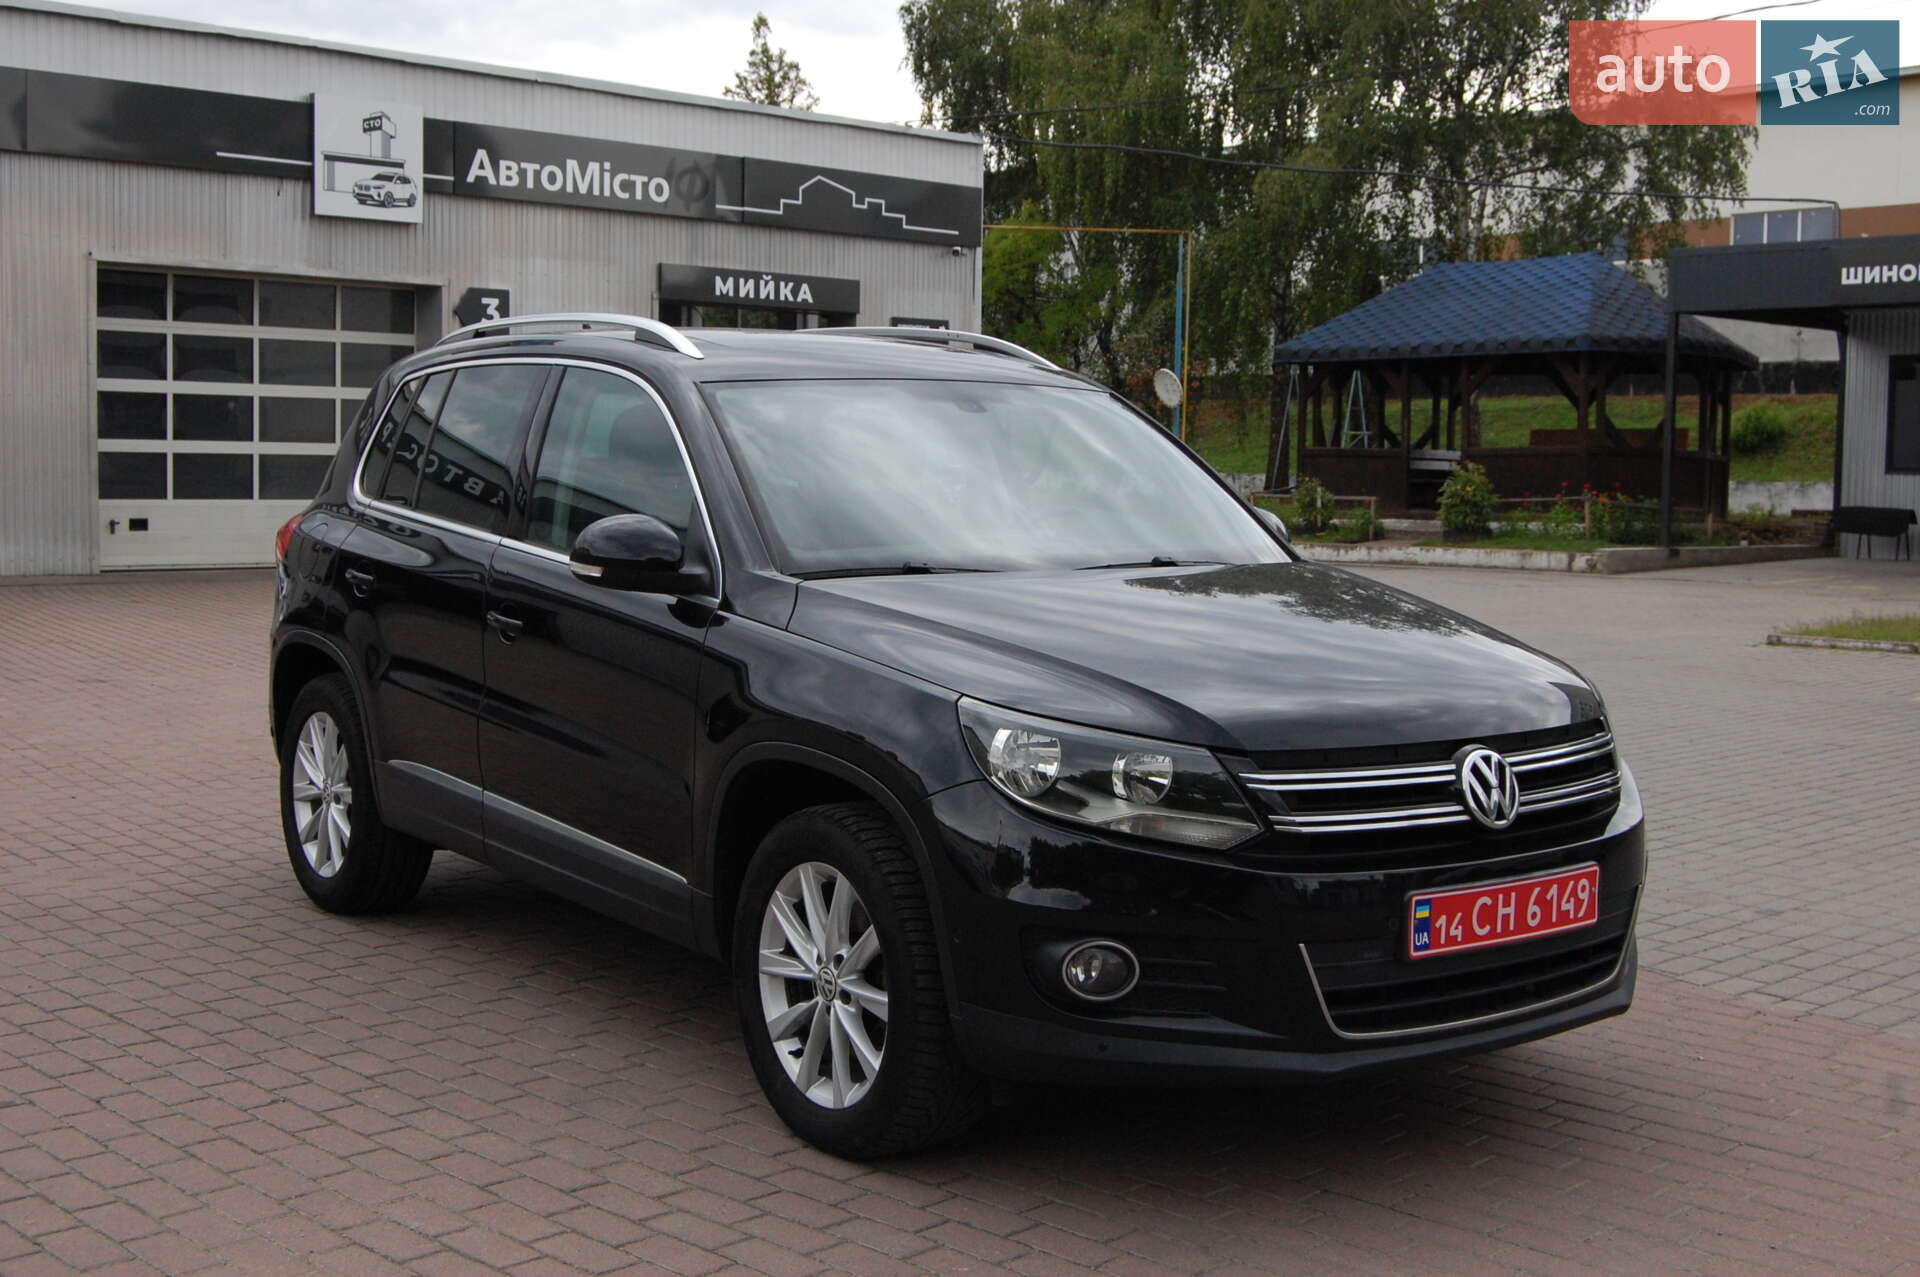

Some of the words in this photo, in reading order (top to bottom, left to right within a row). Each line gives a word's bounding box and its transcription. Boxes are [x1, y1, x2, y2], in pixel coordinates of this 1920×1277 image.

[1841, 263, 1920, 285] ШИНО
[714, 274, 814, 303] МИЙКА
[481, 297, 500, 323] 3
[1435, 911, 1463, 944] 14
[1472, 891, 1516, 936] CH
[1527, 878, 1590, 927] 6149
[1415, 931, 1430, 946] UA
